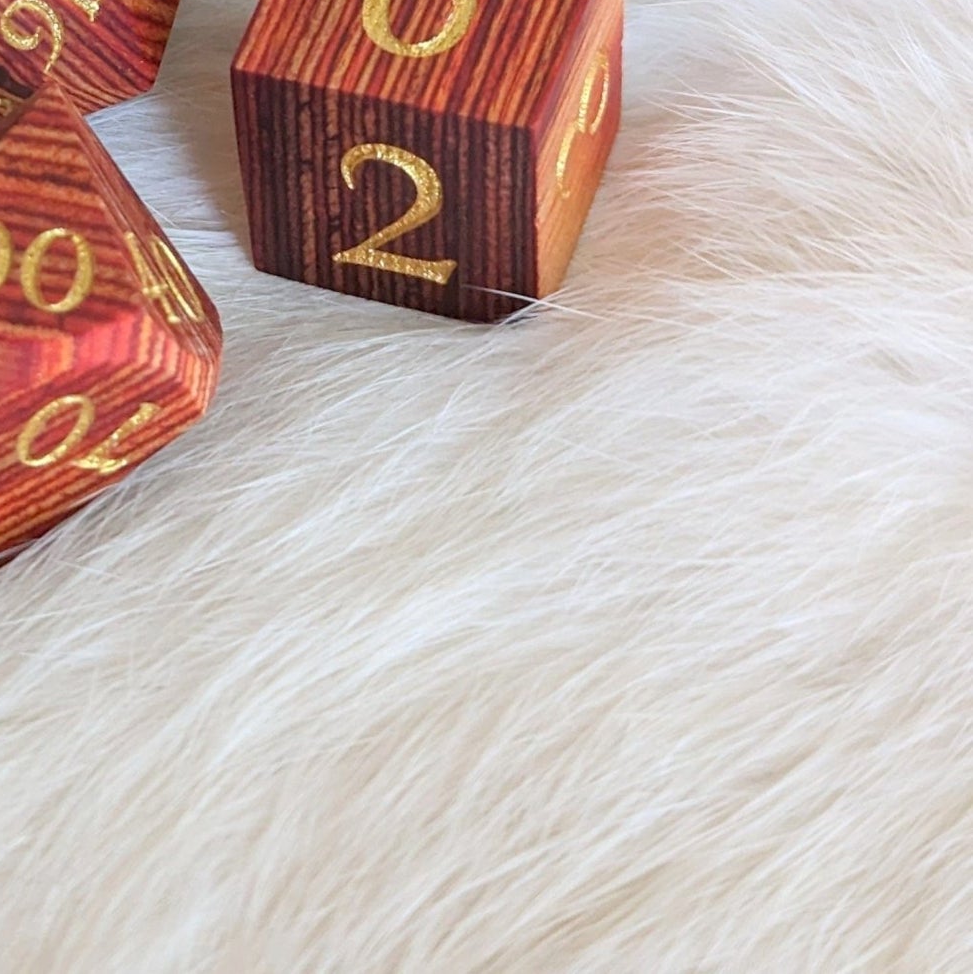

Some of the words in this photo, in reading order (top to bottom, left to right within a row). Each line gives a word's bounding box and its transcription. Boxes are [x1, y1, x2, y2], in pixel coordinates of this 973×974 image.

[332, 142, 458, 285] 2
[125, 231, 205, 325] 40
[16, 393, 163, 474] 70
